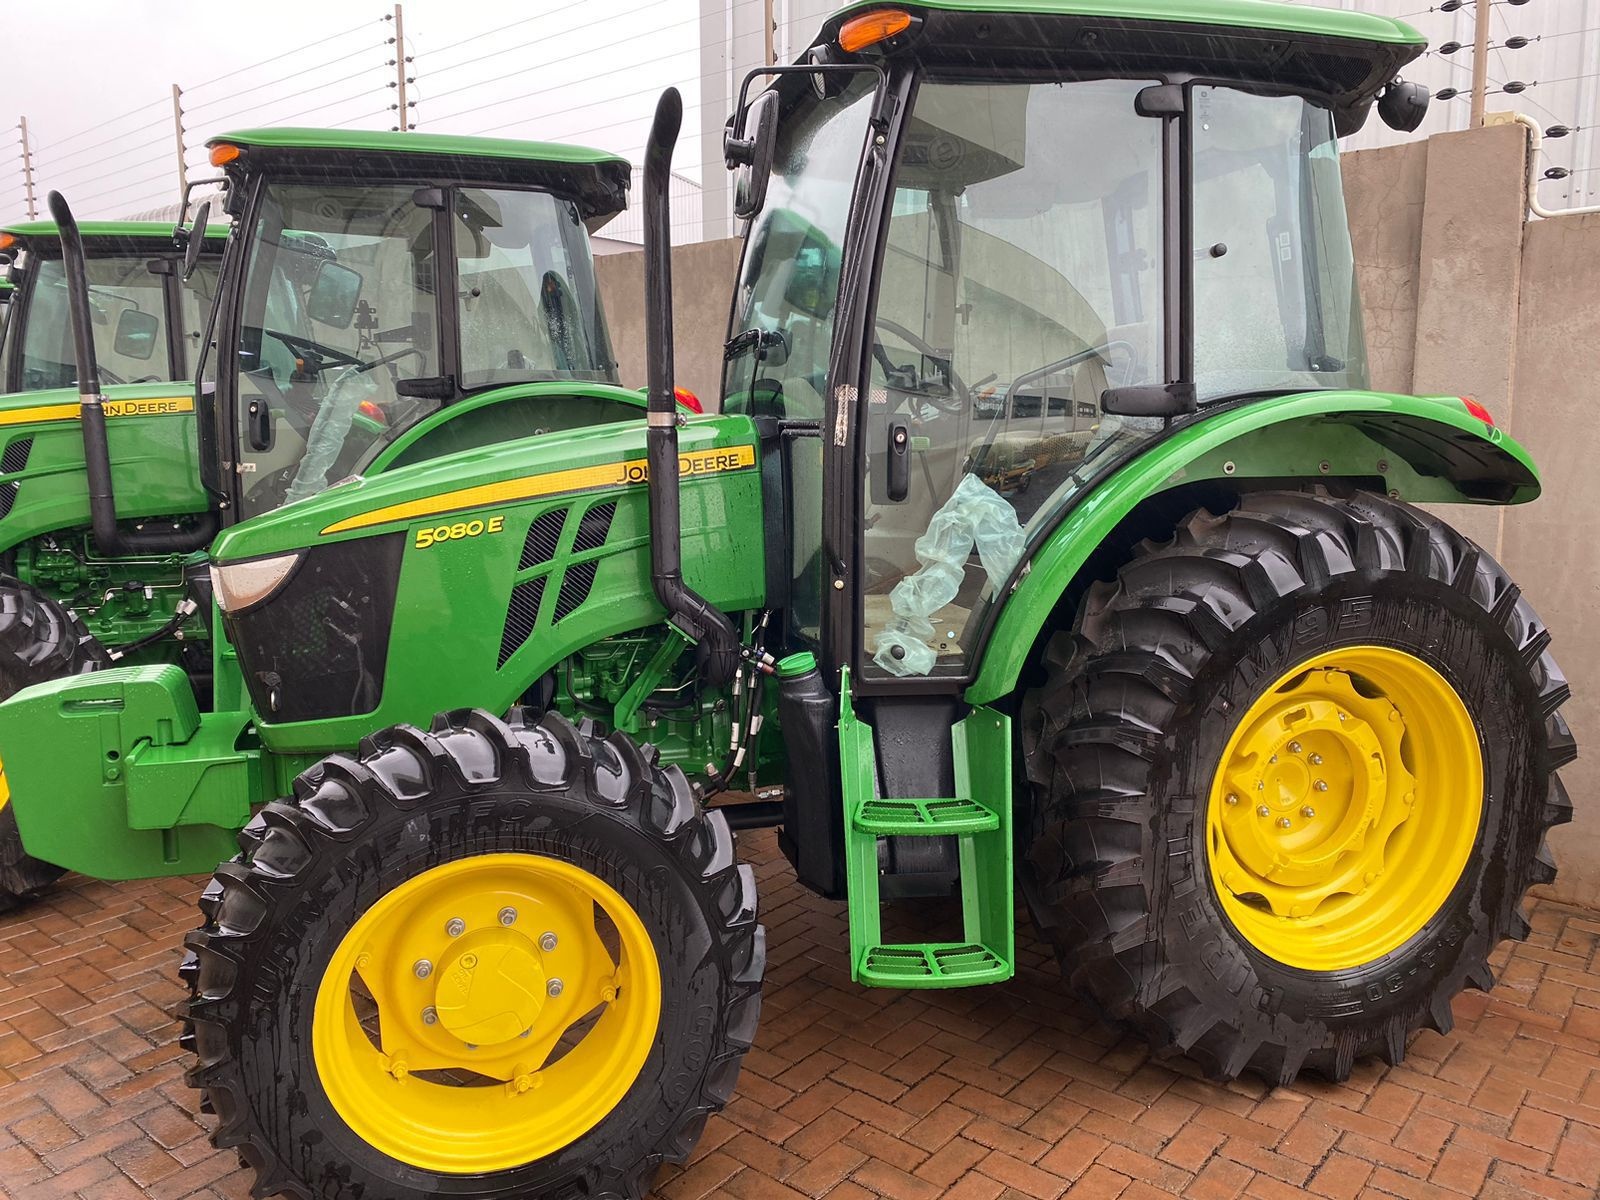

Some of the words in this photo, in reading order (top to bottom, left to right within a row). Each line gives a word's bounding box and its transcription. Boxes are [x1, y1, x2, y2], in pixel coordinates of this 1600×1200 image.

[125, 402, 178, 414] DEERE
[616, 464, 648, 483] JO
[678, 453, 740, 475] DEERE
[415, 519, 485, 549] 5080
[487, 515, 505, 533] E
